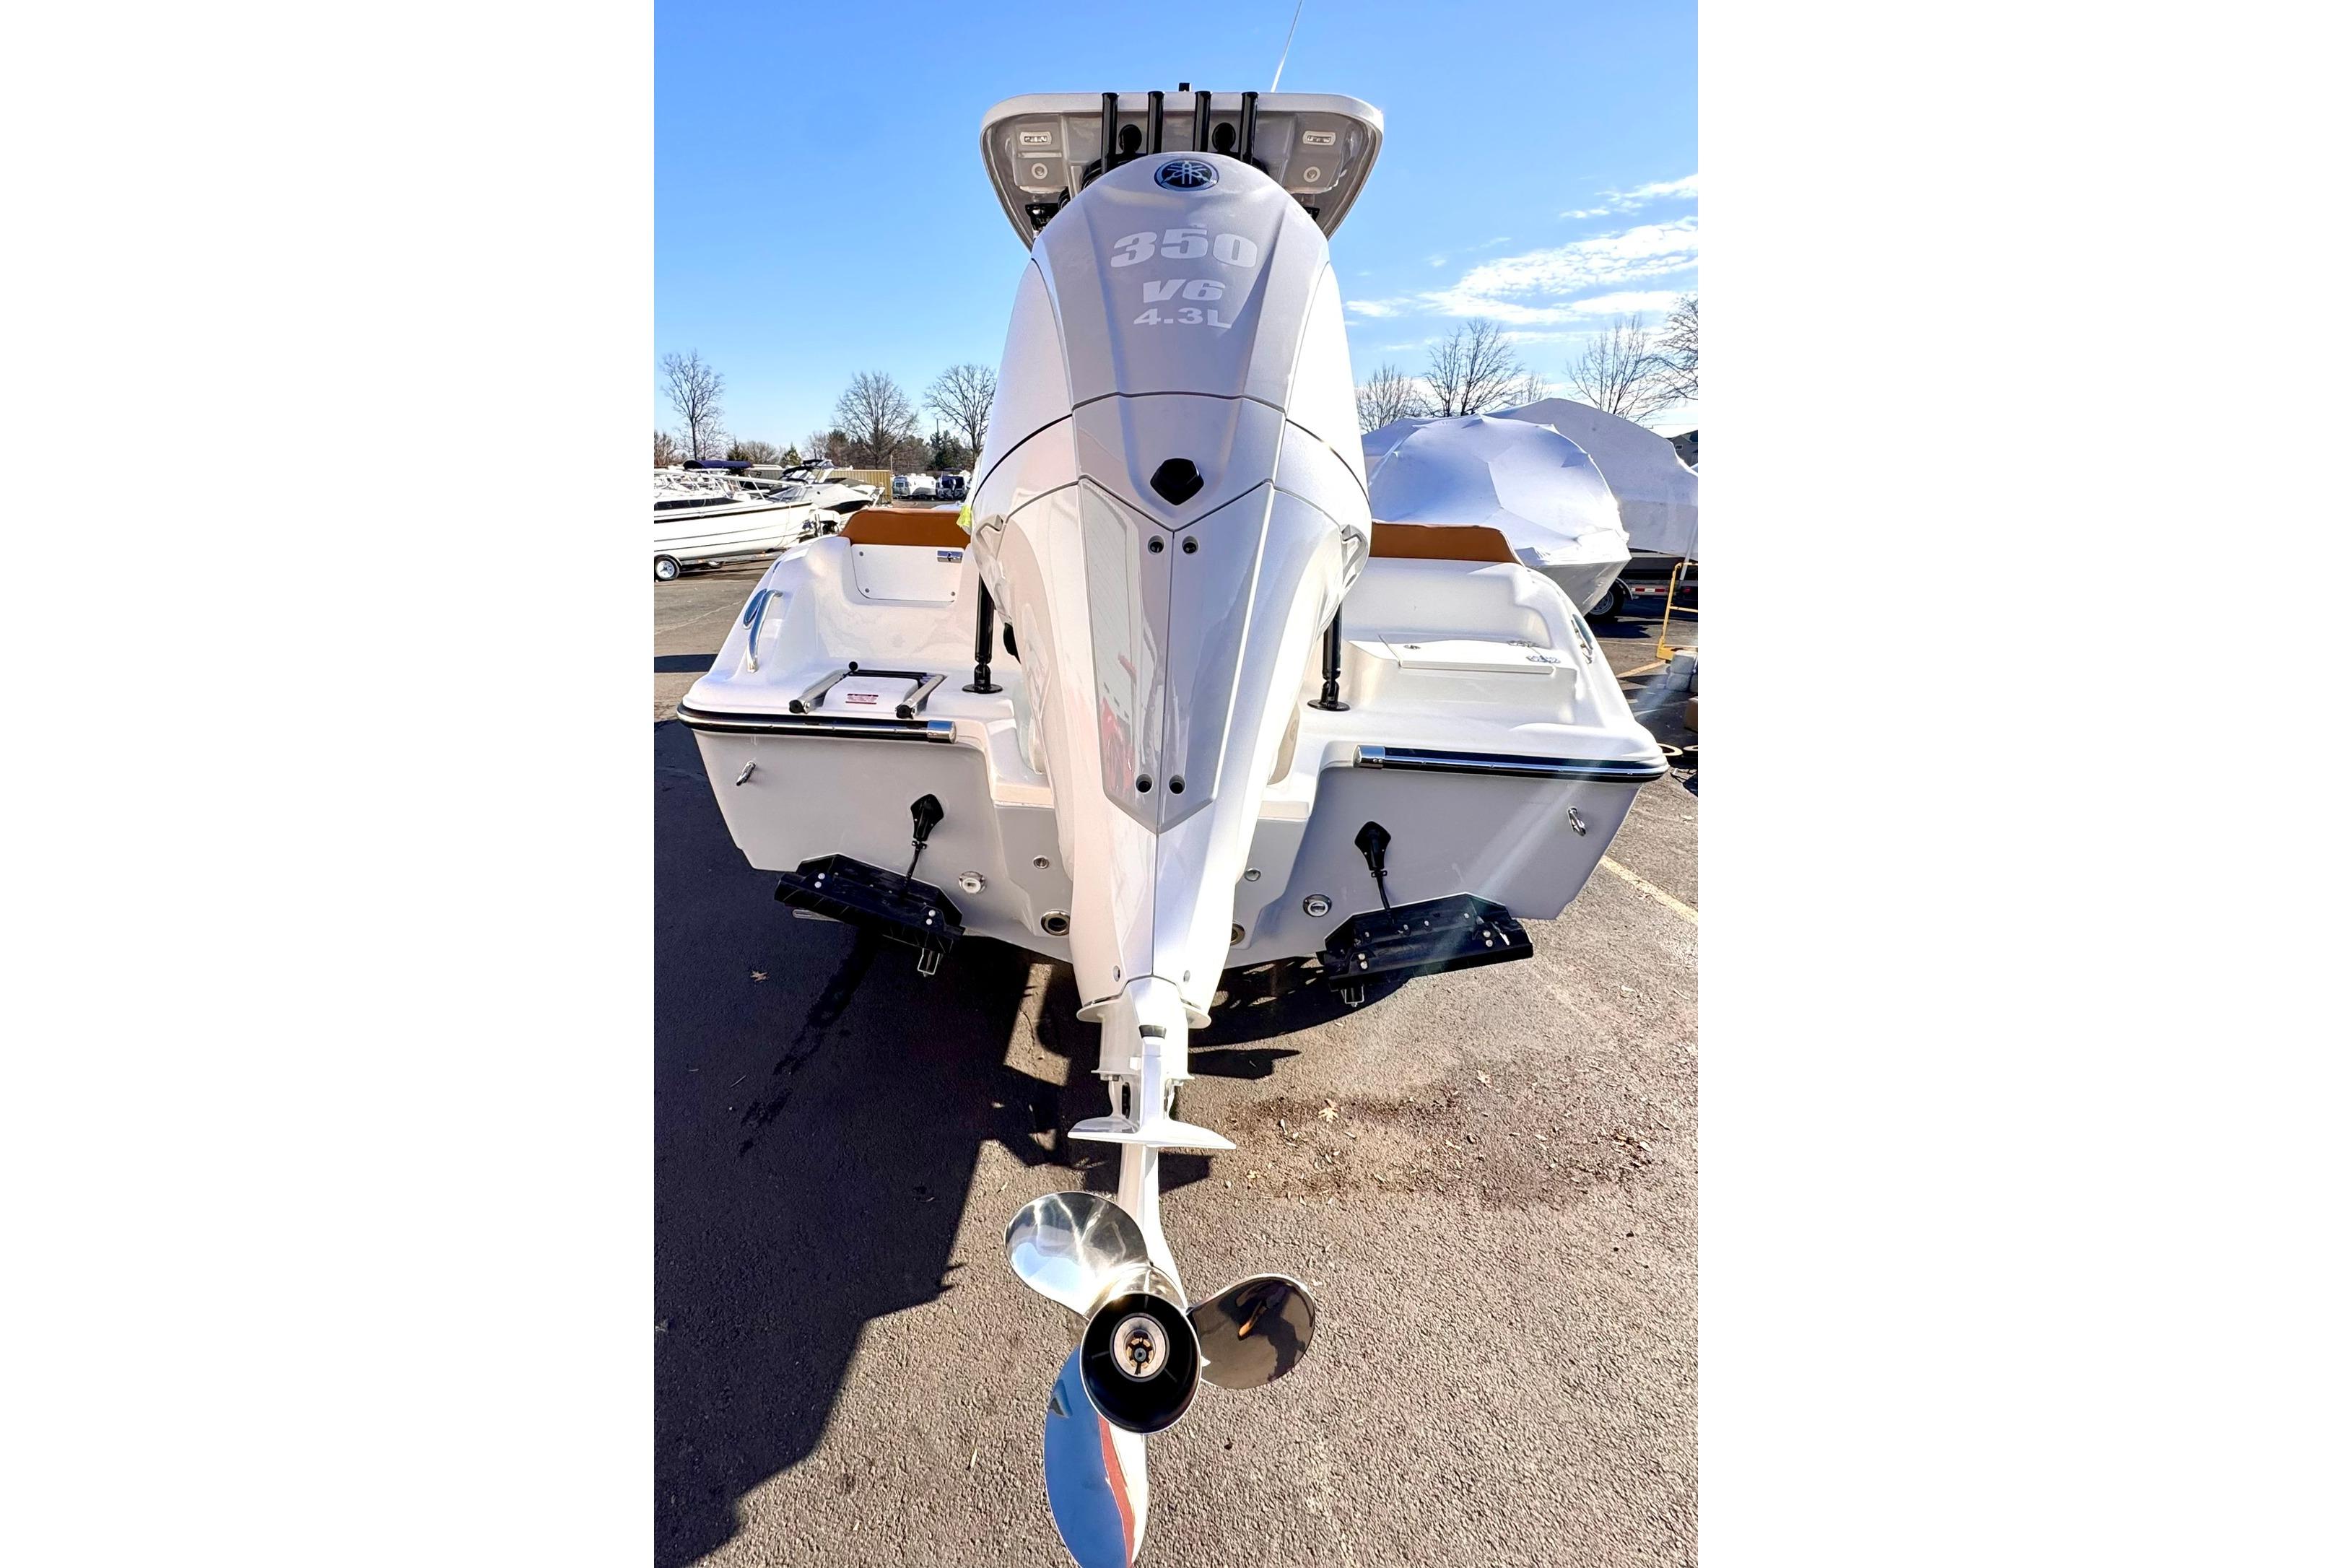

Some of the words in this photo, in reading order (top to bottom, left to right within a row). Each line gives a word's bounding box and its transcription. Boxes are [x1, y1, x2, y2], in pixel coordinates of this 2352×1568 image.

[1110, 228, 1258, 268] 350
[1143, 279, 1226, 303] V6
[1133, 308, 1232, 329] 4.3L
